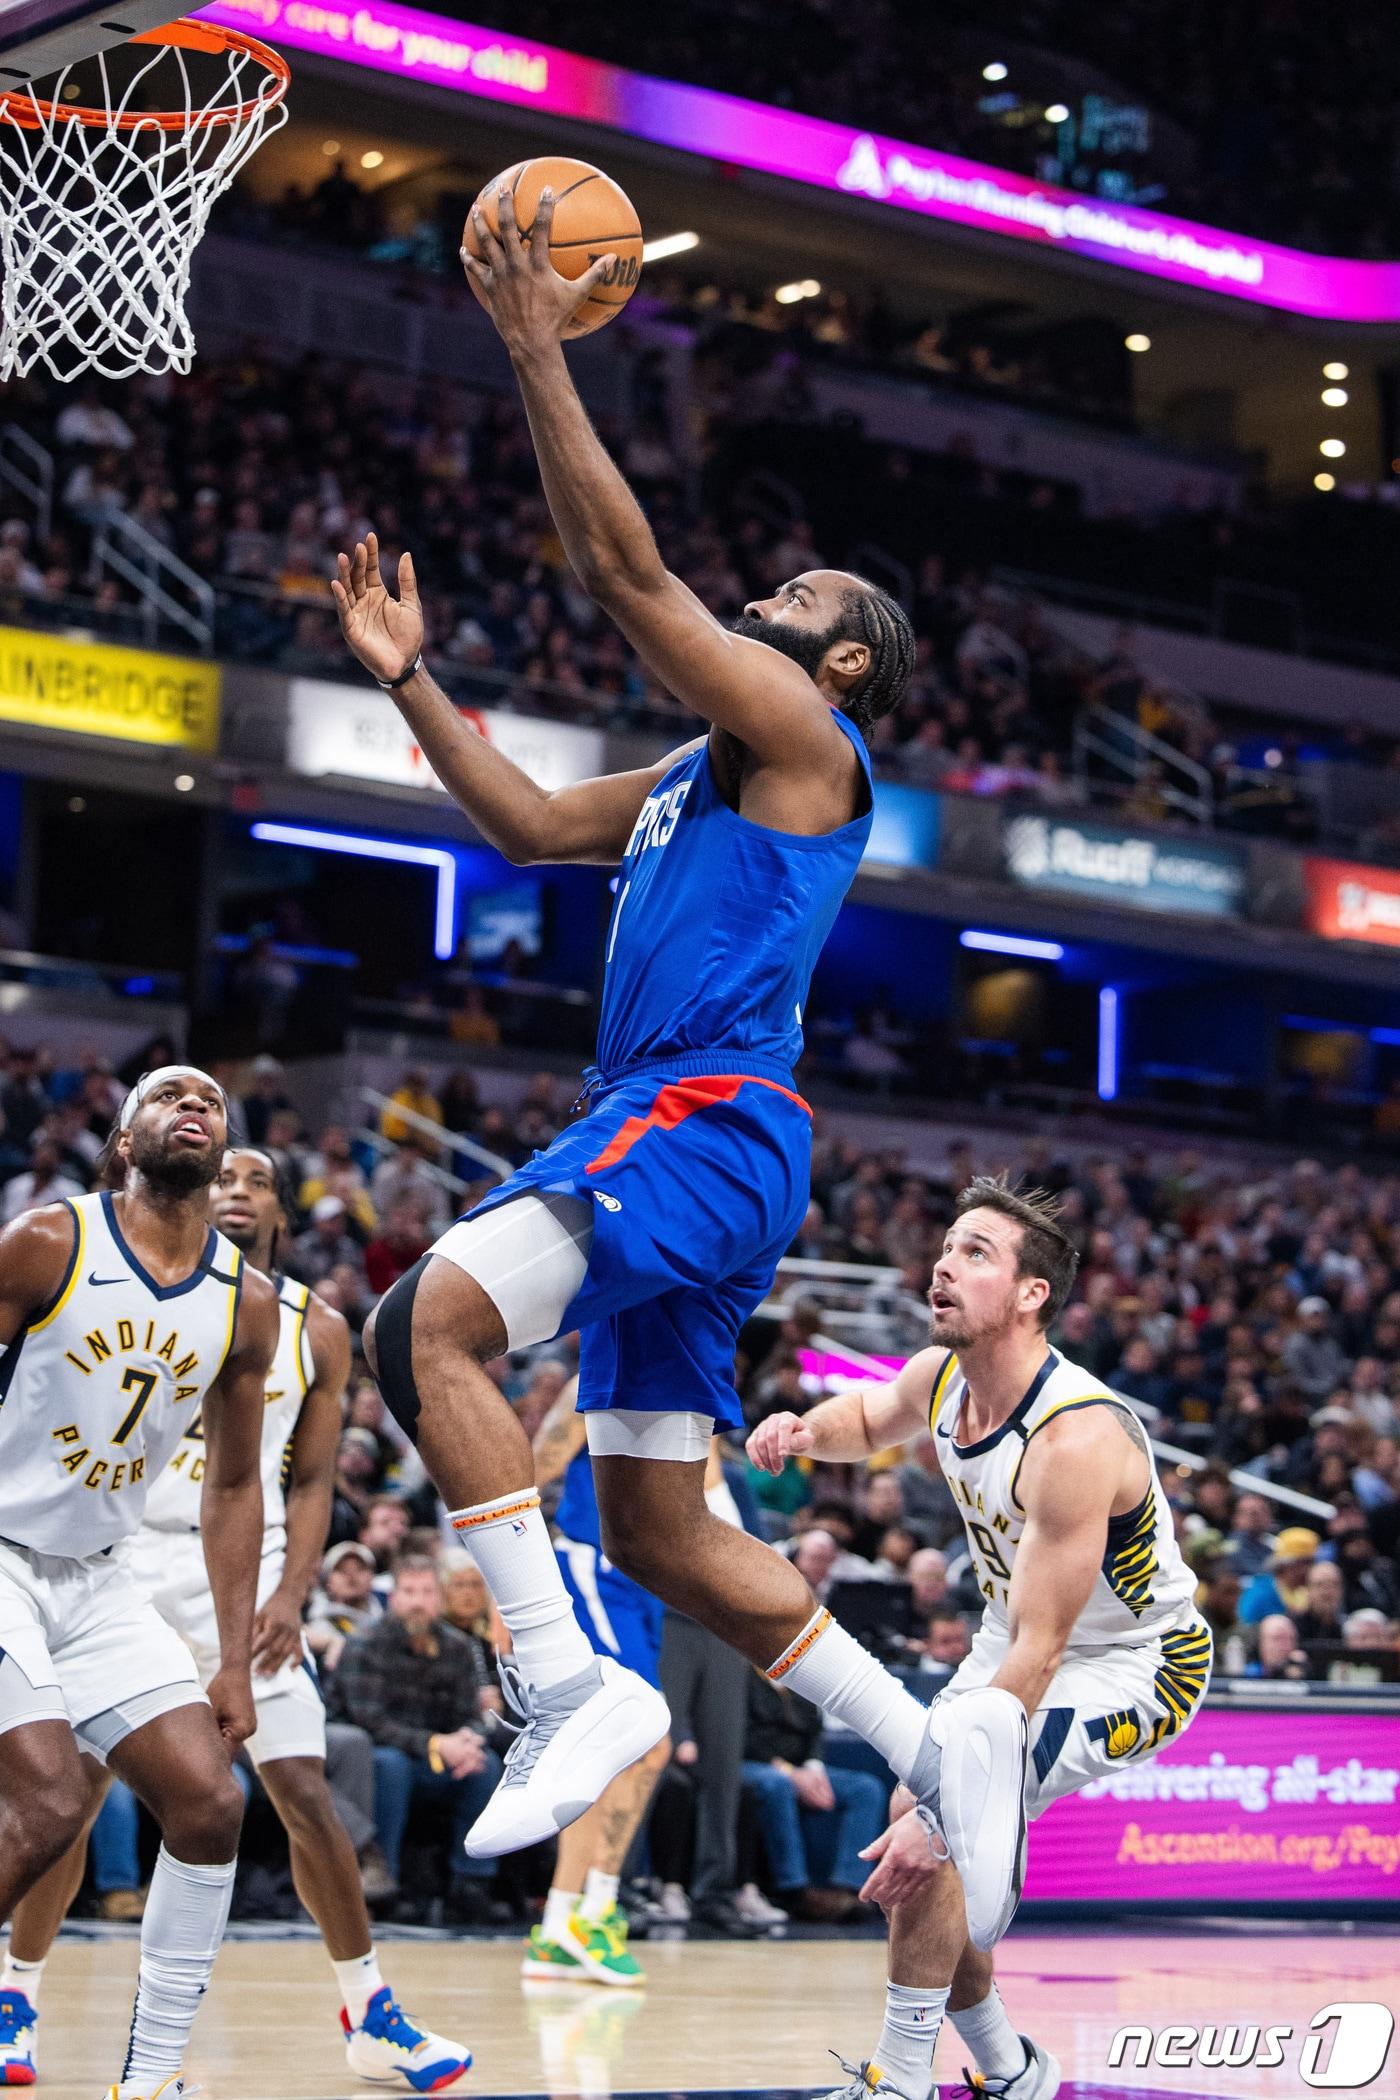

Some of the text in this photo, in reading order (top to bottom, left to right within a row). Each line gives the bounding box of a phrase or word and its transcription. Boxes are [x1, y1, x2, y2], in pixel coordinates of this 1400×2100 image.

[64, 1319, 199, 1404] INDIANA
[111, 1367, 158, 1447] 7
[967, 1521, 1011, 1581] 9
